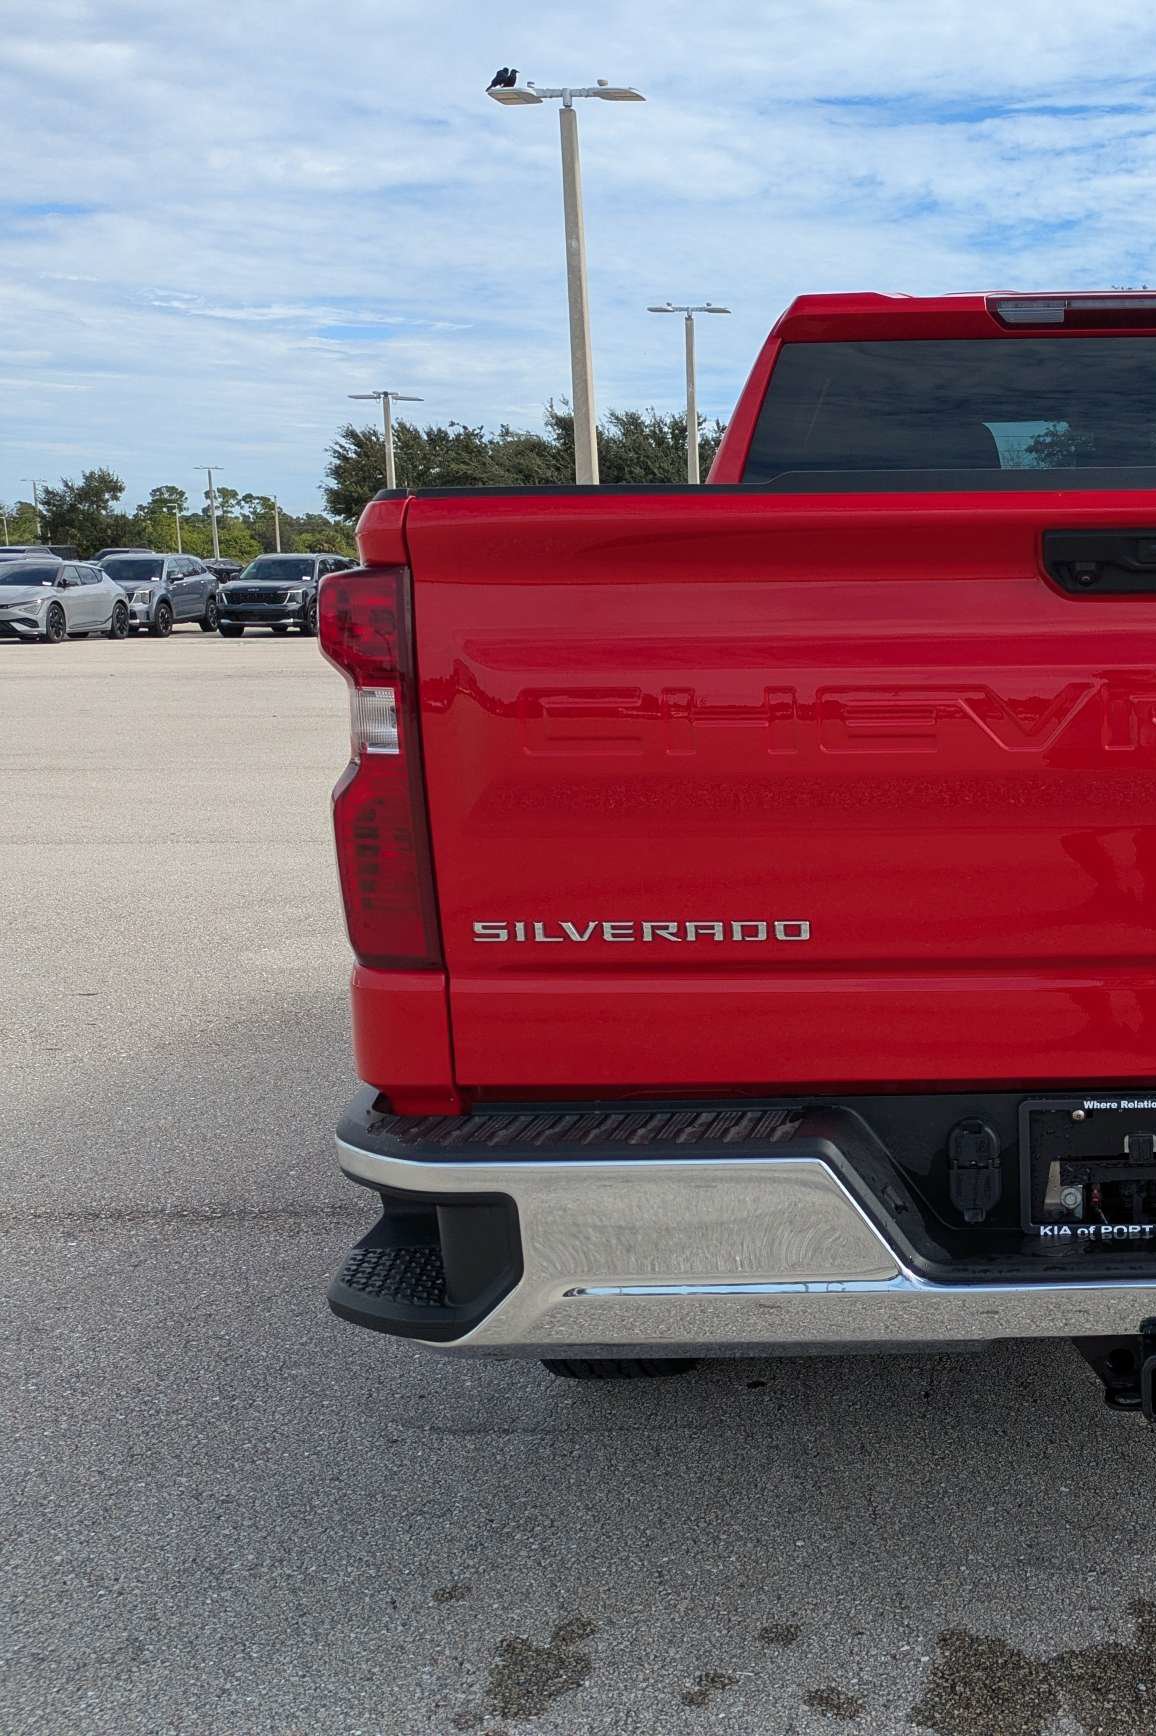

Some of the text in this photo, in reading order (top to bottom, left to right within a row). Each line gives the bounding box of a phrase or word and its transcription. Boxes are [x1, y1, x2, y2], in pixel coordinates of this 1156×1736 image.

[472, 920, 812, 943] SILVERADO
[1083, 1100, 1118, 1109] Where
[1040, 1225, 1072, 1236] KIA
[1077, 1225, 1096, 1237] of
